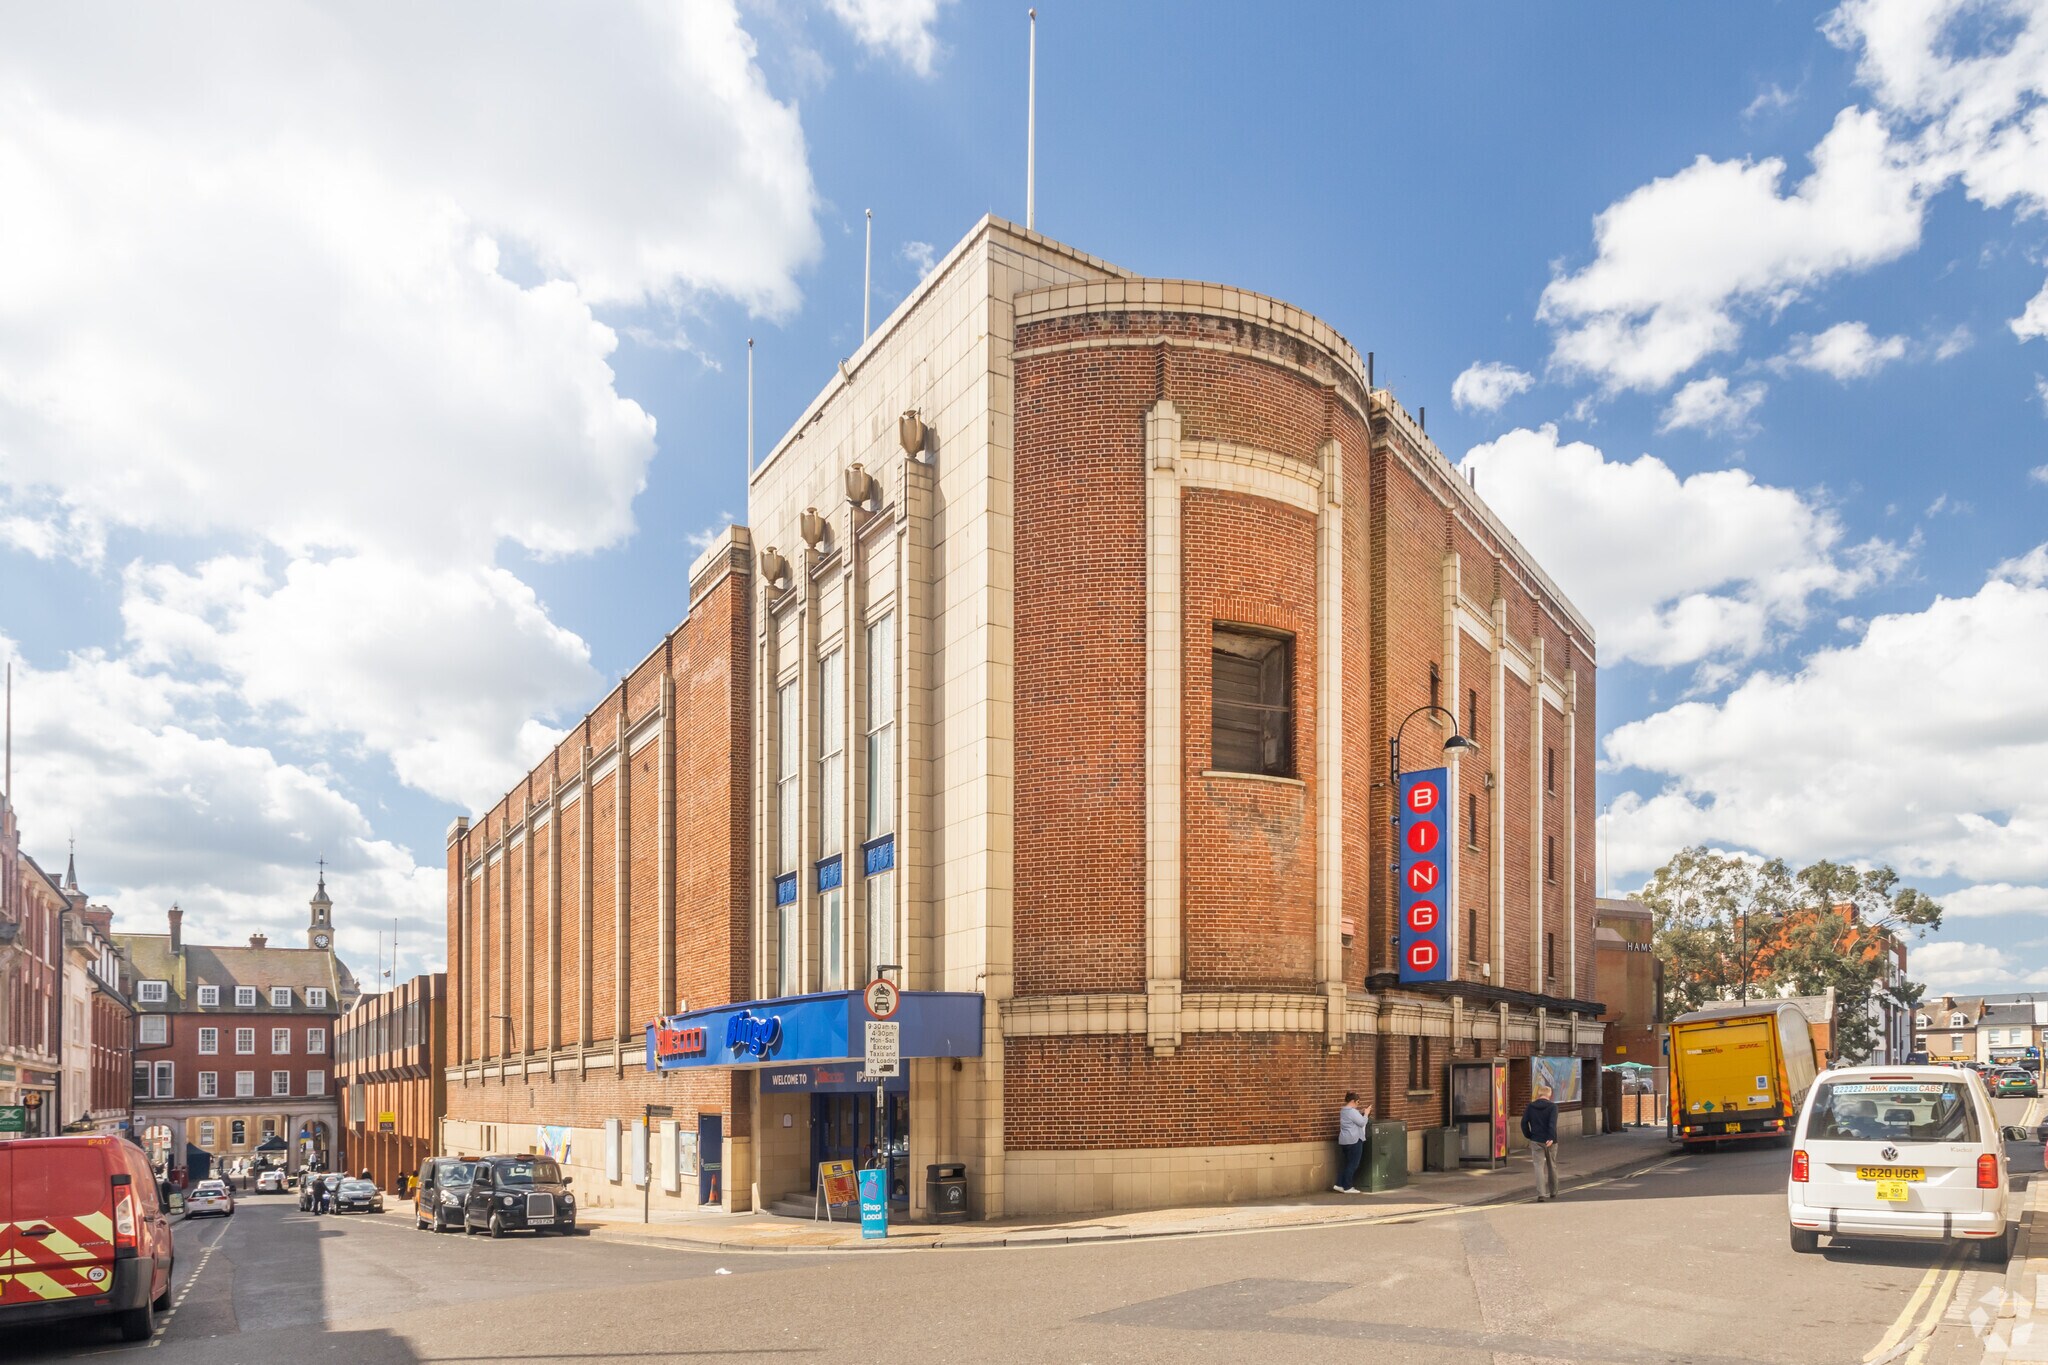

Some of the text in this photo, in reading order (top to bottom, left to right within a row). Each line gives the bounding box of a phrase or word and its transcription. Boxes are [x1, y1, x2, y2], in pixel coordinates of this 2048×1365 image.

[1413, 788, 1433, 965] BINGO
[1627, 942, 1653, 952] HAMS
[772, 1074, 799, 1086] WELCOME
[799, 1073, 807, 1085] TO
[1834, 1086, 1863, 1094] 222222
[1864, 1085, 1888, 1093] HAWK
[1918, 1084, 1942, 1092] CABS
[1861, 1168, 1919, 1178] SG20 UGR
[862, 1203, 881, 1212] Shop
[863, 1212, 882, 1220] Local
